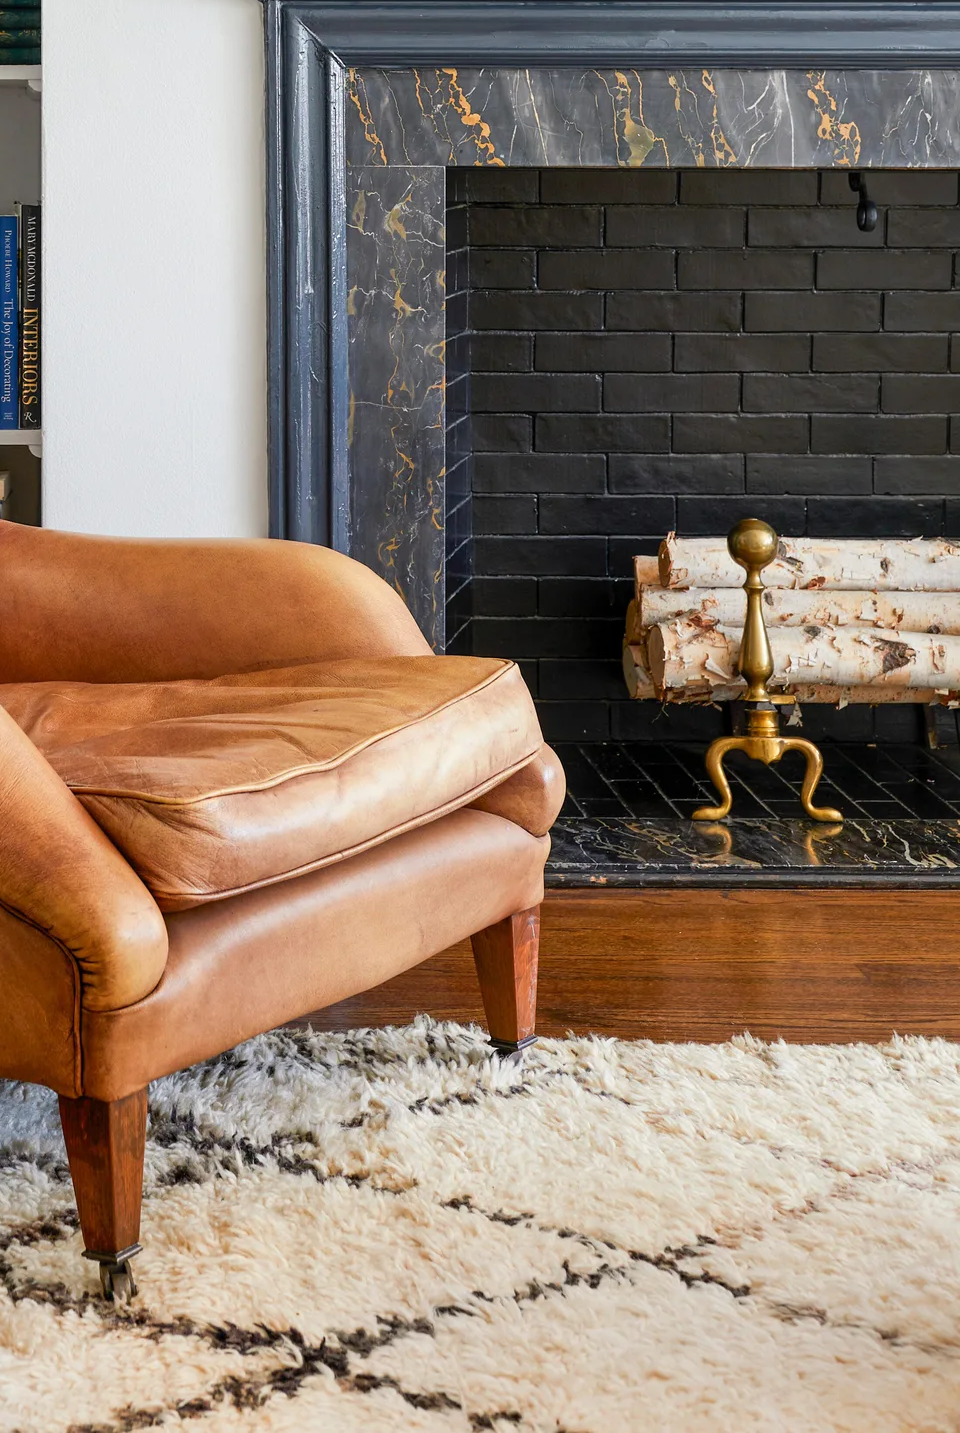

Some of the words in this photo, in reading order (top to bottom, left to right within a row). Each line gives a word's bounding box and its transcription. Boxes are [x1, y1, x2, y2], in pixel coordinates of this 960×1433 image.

[27, 217, 36, 243] MARY
[27, 246, 36, 301] MCDONALD
[4, 298, 14, 319] The
[1, 321, 13, 334] Joy
[4, 338, 14, 348] of
[22, 309, 38, 405] INTERIORS
[1, 351, 13, 402] Decorating
